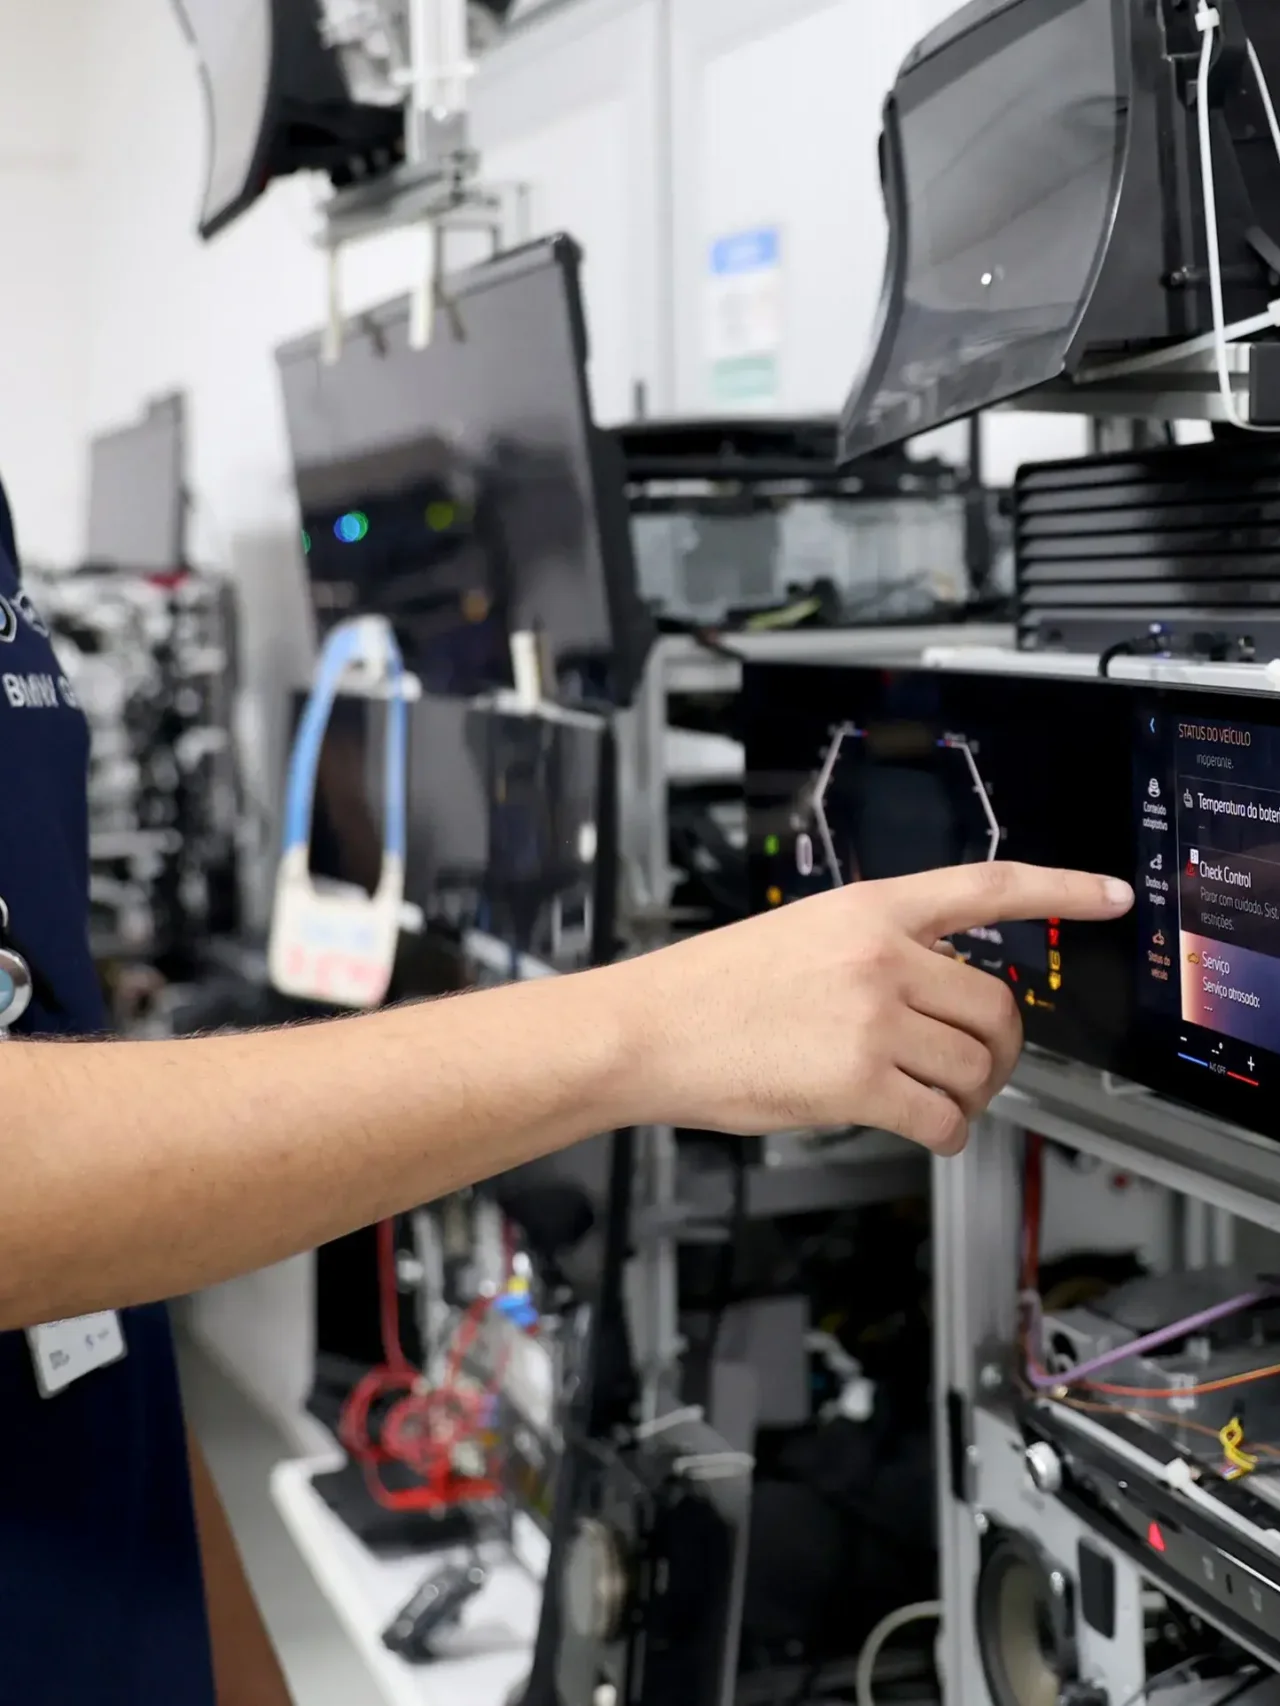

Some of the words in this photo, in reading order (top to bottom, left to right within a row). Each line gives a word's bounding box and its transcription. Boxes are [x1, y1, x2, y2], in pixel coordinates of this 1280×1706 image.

[2, 673, 59, 708] BMW
[1179, 723, 1206, 741] STATUS
[1207, 727, 1219, 742] DO
[1219, 727, 1251, 747] VEÍCULO
[1197, 792, 1246, 815] Temperatura
[1247, 801, 1258, 819] da
[1200, 860, 1223, 882] Check
[1223, 866, 1252, 888] Control
[1219, 893, 1234, 908] com
[1202, 950, 1230, 976] Serviço
[1203, 976, 1228, 999] Serviço
